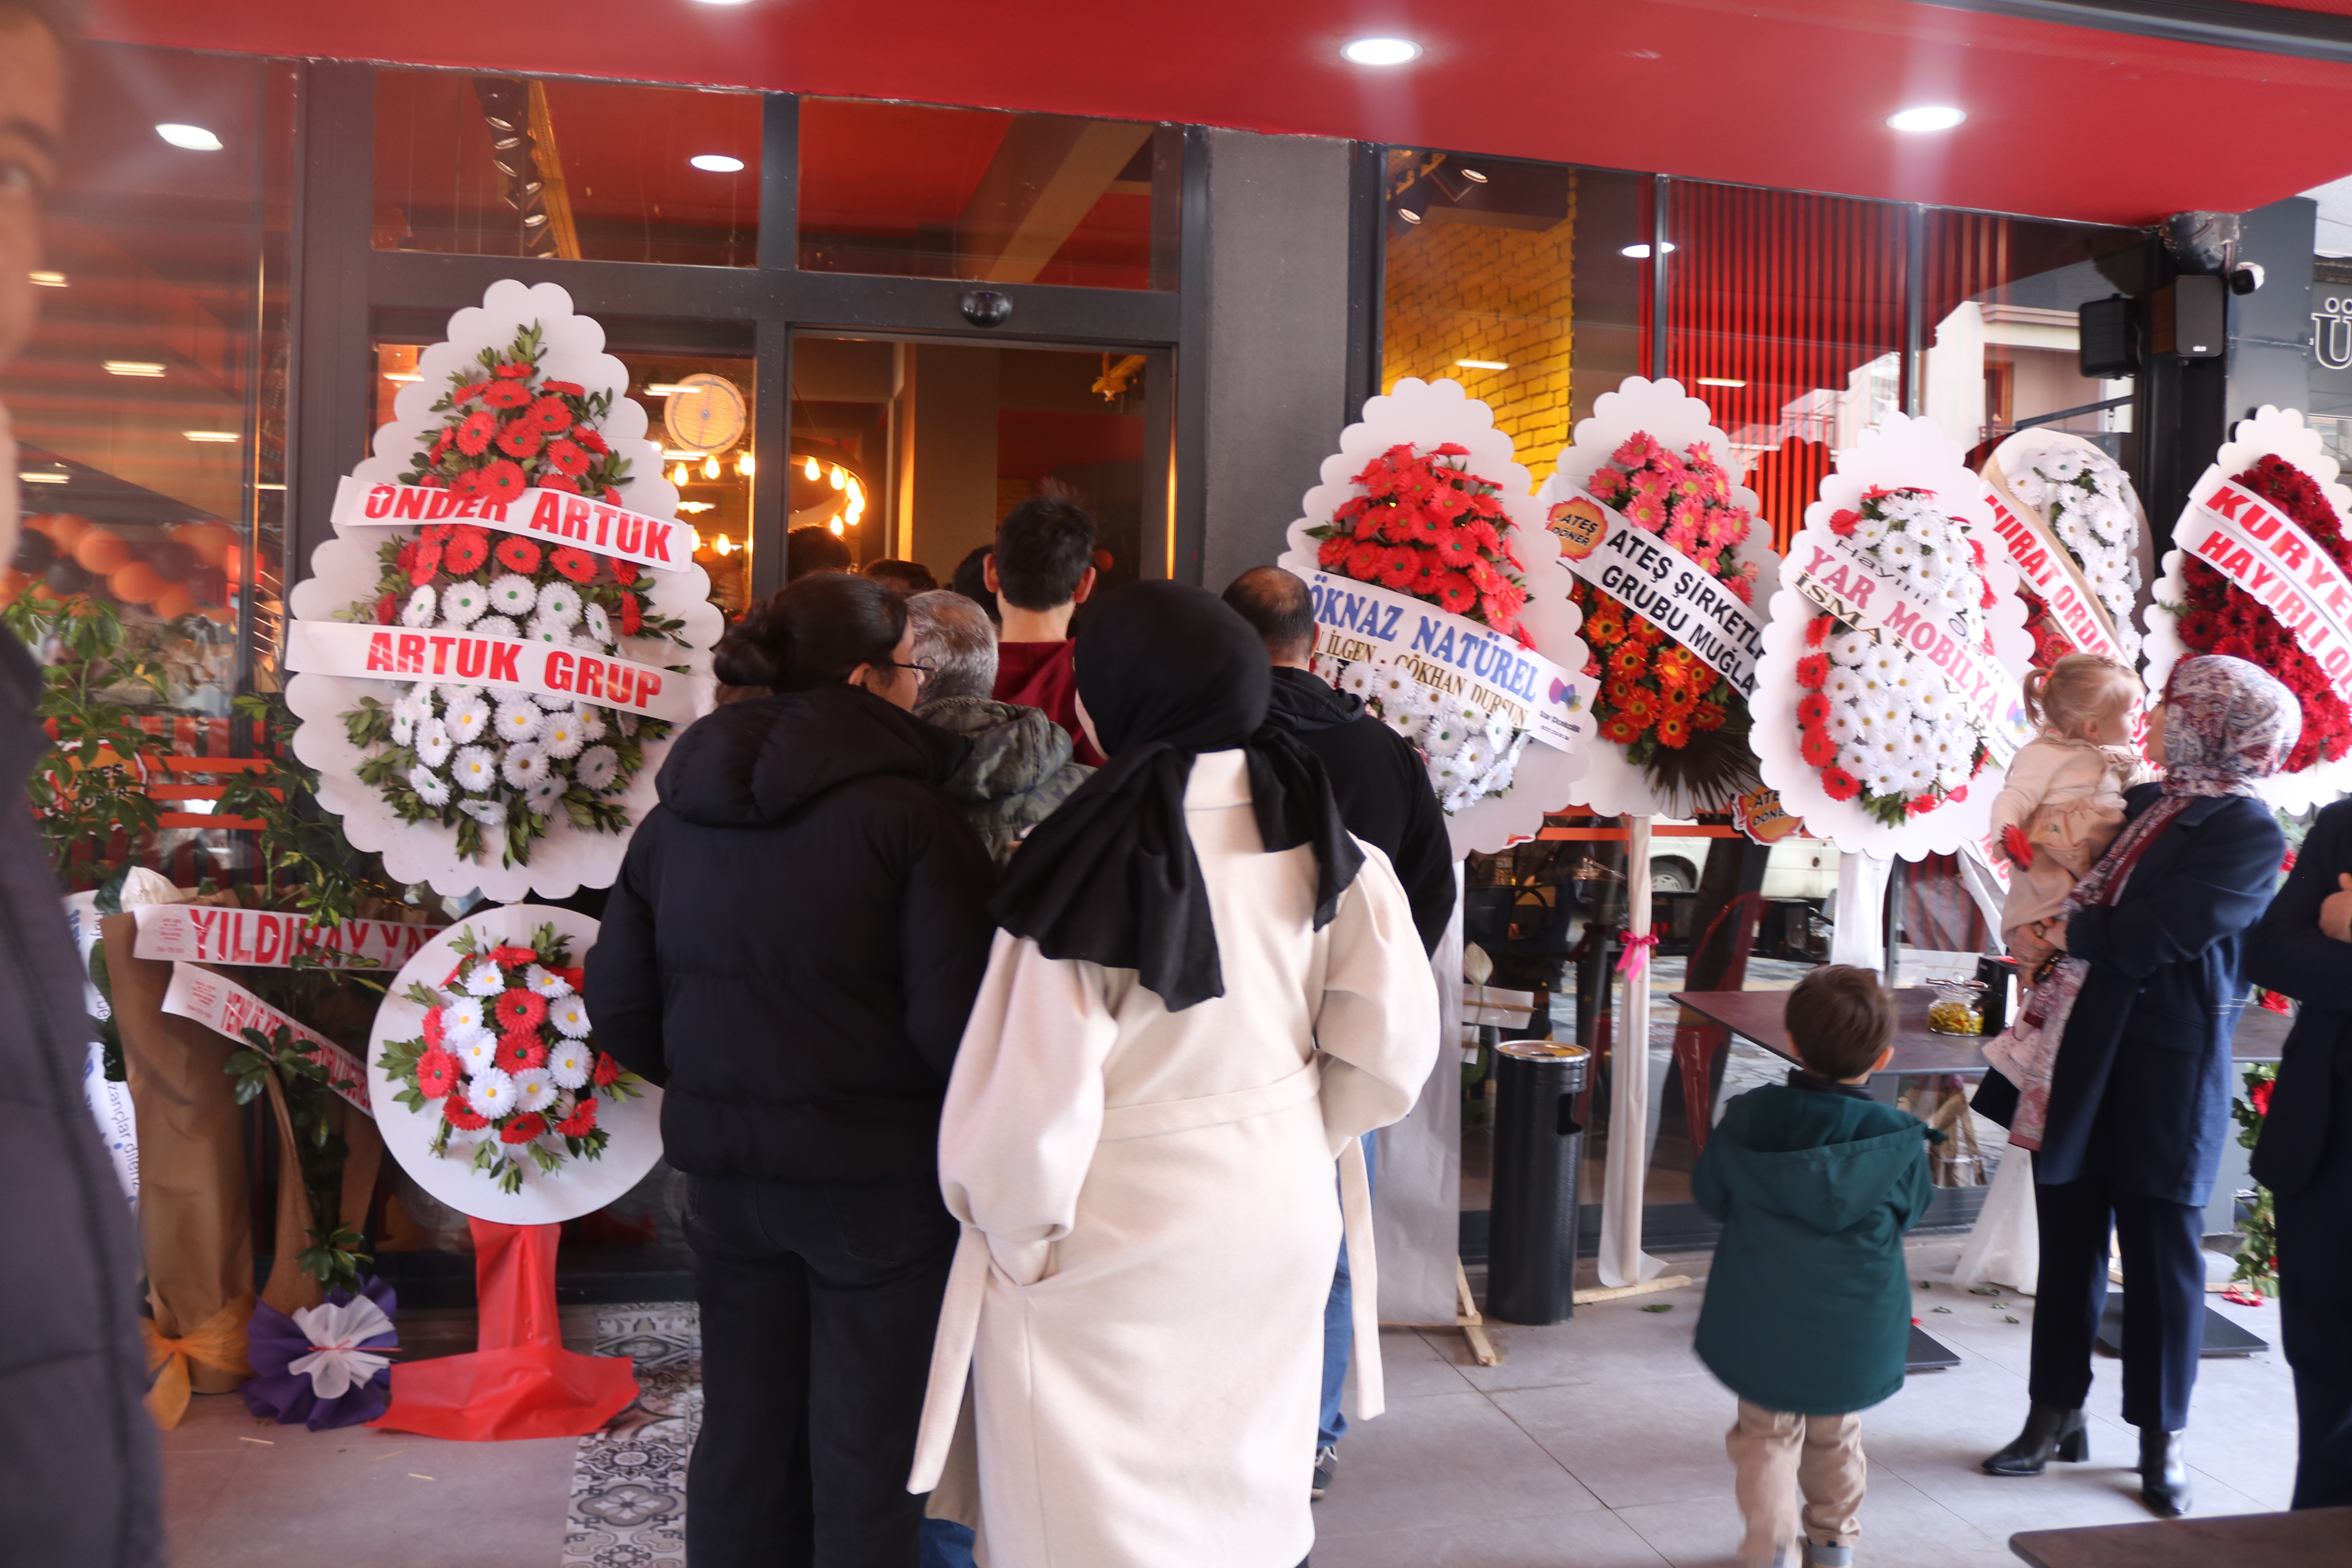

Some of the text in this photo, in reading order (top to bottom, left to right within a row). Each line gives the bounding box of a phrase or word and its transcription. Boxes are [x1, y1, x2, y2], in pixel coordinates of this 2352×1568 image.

[365, 483, 673, 563] ÖNDER ARTUK
[1551, 527, 1590, 547] DÖNER
[1559, 514, 1598, 535] ATEŞ
[1607, 530, 1673, 583] ATEŞ
[1310, 574, 1539, 703] ÖKNAZ NATÜREL
[1326, 630, 1377, 663] İLGEN
[1602, 566, 1755, 695] GRUBU MUĞLA
[1805, 546, 1998, 722] YAR MOBİLYA
[2052, 585, 2118, 654] ORDA
[2197, 530, 2352, 702] HAYIRLI OL
[366, 633, 662, 708] ARTUK GRUP
[1754, 808, 1786, 827] DÖNE
[1755, 791, 1780, 809] ATE
[189, 909, 369, 967] YILDIRAY
